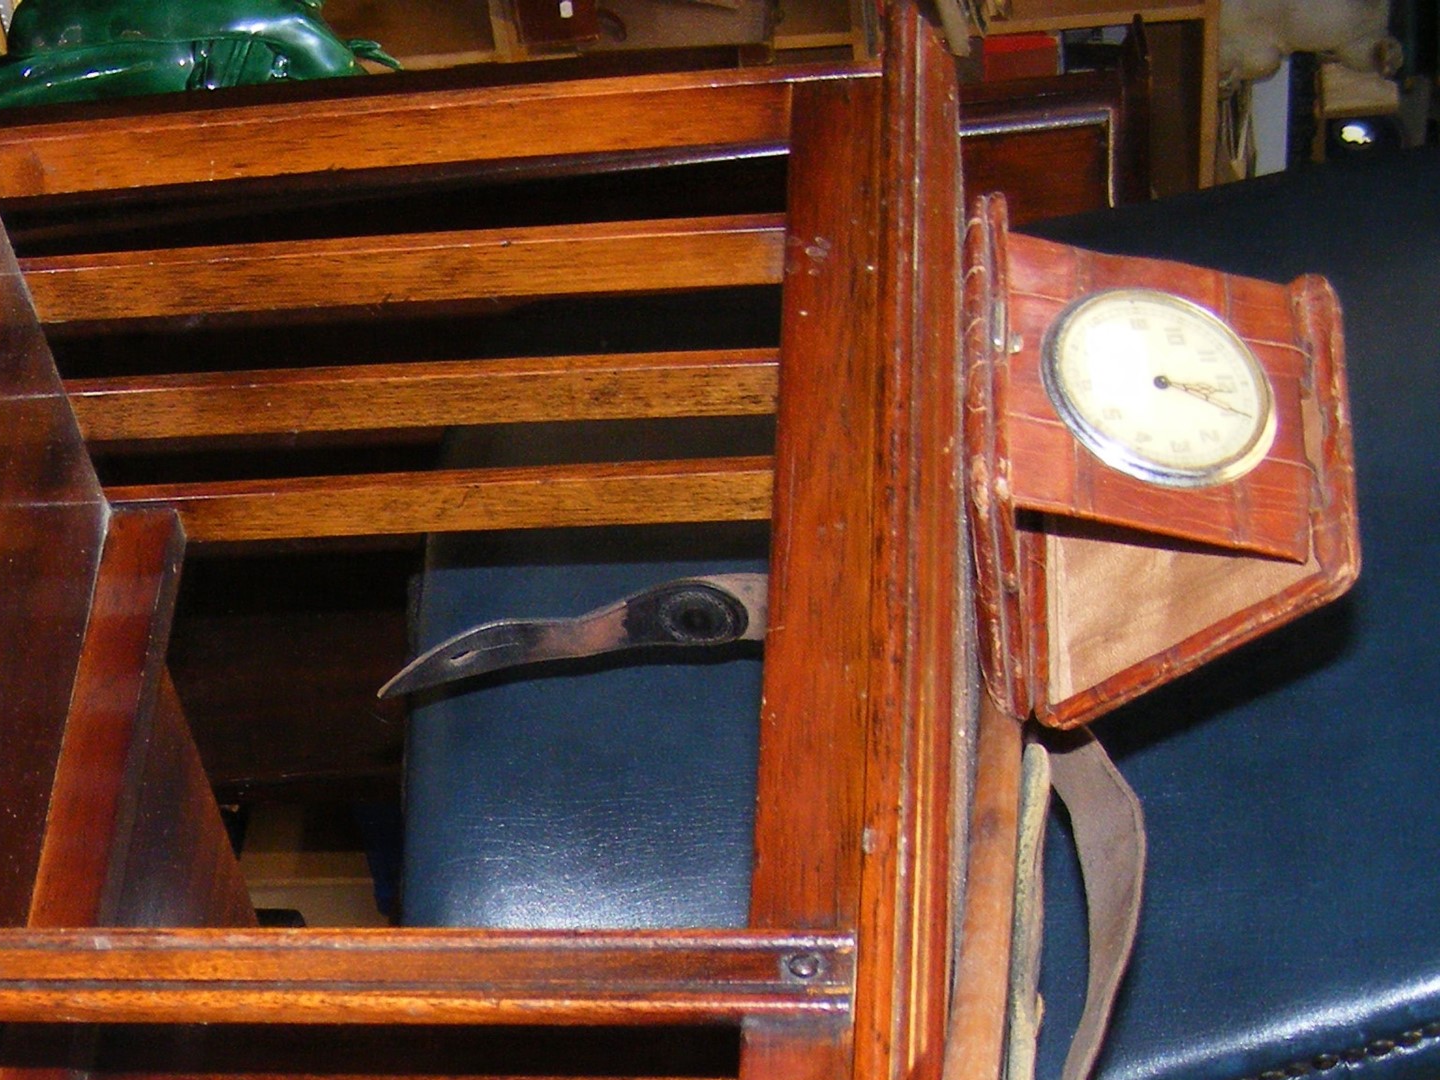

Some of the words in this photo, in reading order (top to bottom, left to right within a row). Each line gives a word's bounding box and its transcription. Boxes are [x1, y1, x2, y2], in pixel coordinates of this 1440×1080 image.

[1164, 327, 1186, 345] 10
[1198, 351, 1217, 362] 11
[1102, 407, 1122, 420] 5
[1135, 431, 1153, 443] 4
[1200, 429, 1220, 442] 2
[1170, 440, 1191, 453] 3
